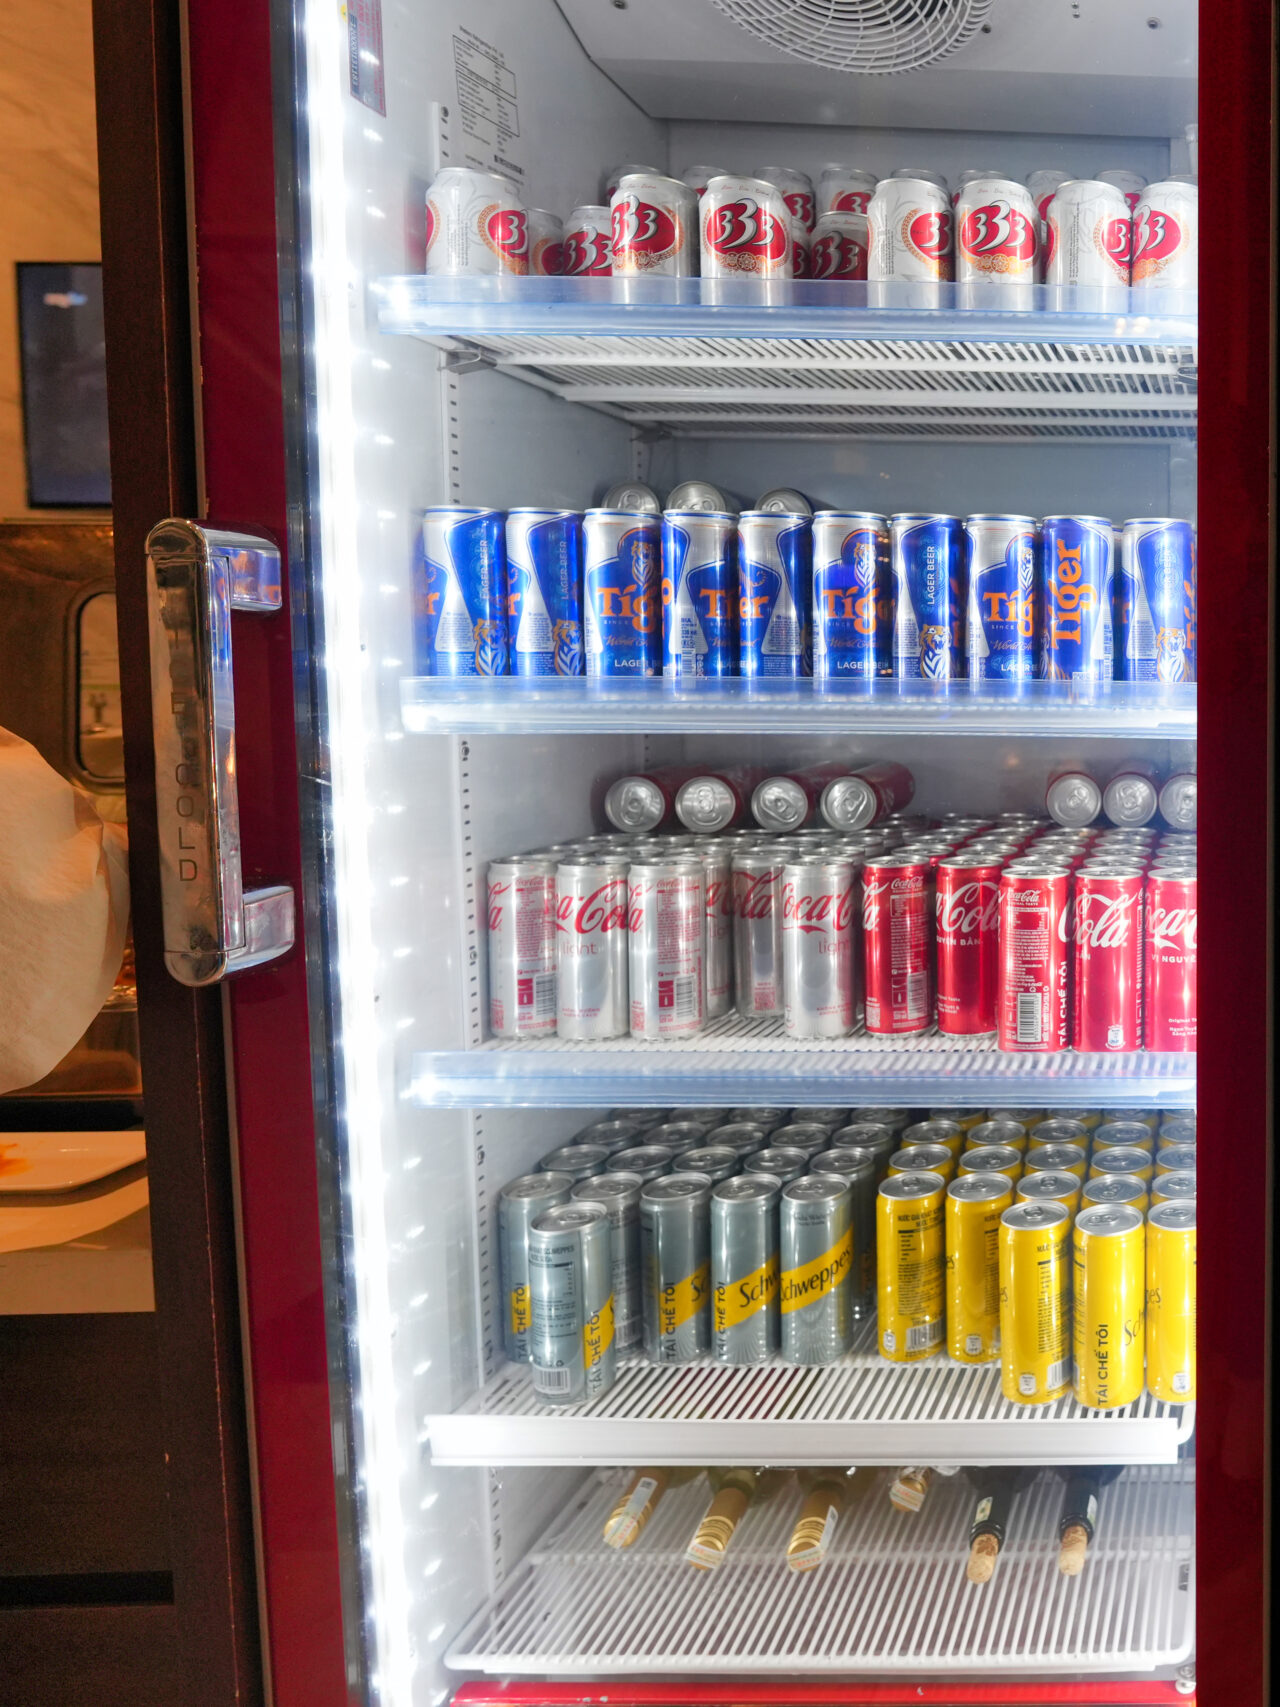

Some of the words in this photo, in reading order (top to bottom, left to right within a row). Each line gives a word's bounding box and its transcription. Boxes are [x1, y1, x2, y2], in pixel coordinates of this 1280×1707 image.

[713, 198, 774, 249] 333
[966, 200, 1026, 252] 333
[927, 546, 935, 571] BEER
[597, 584, 657, 633] Tig
[927, 573, 935, 605] LAGER
[982, 589, 1035, 637] Tig
[1048, 539, 1097, 650] Tiger
[175, 762, 199, 882] COLD
